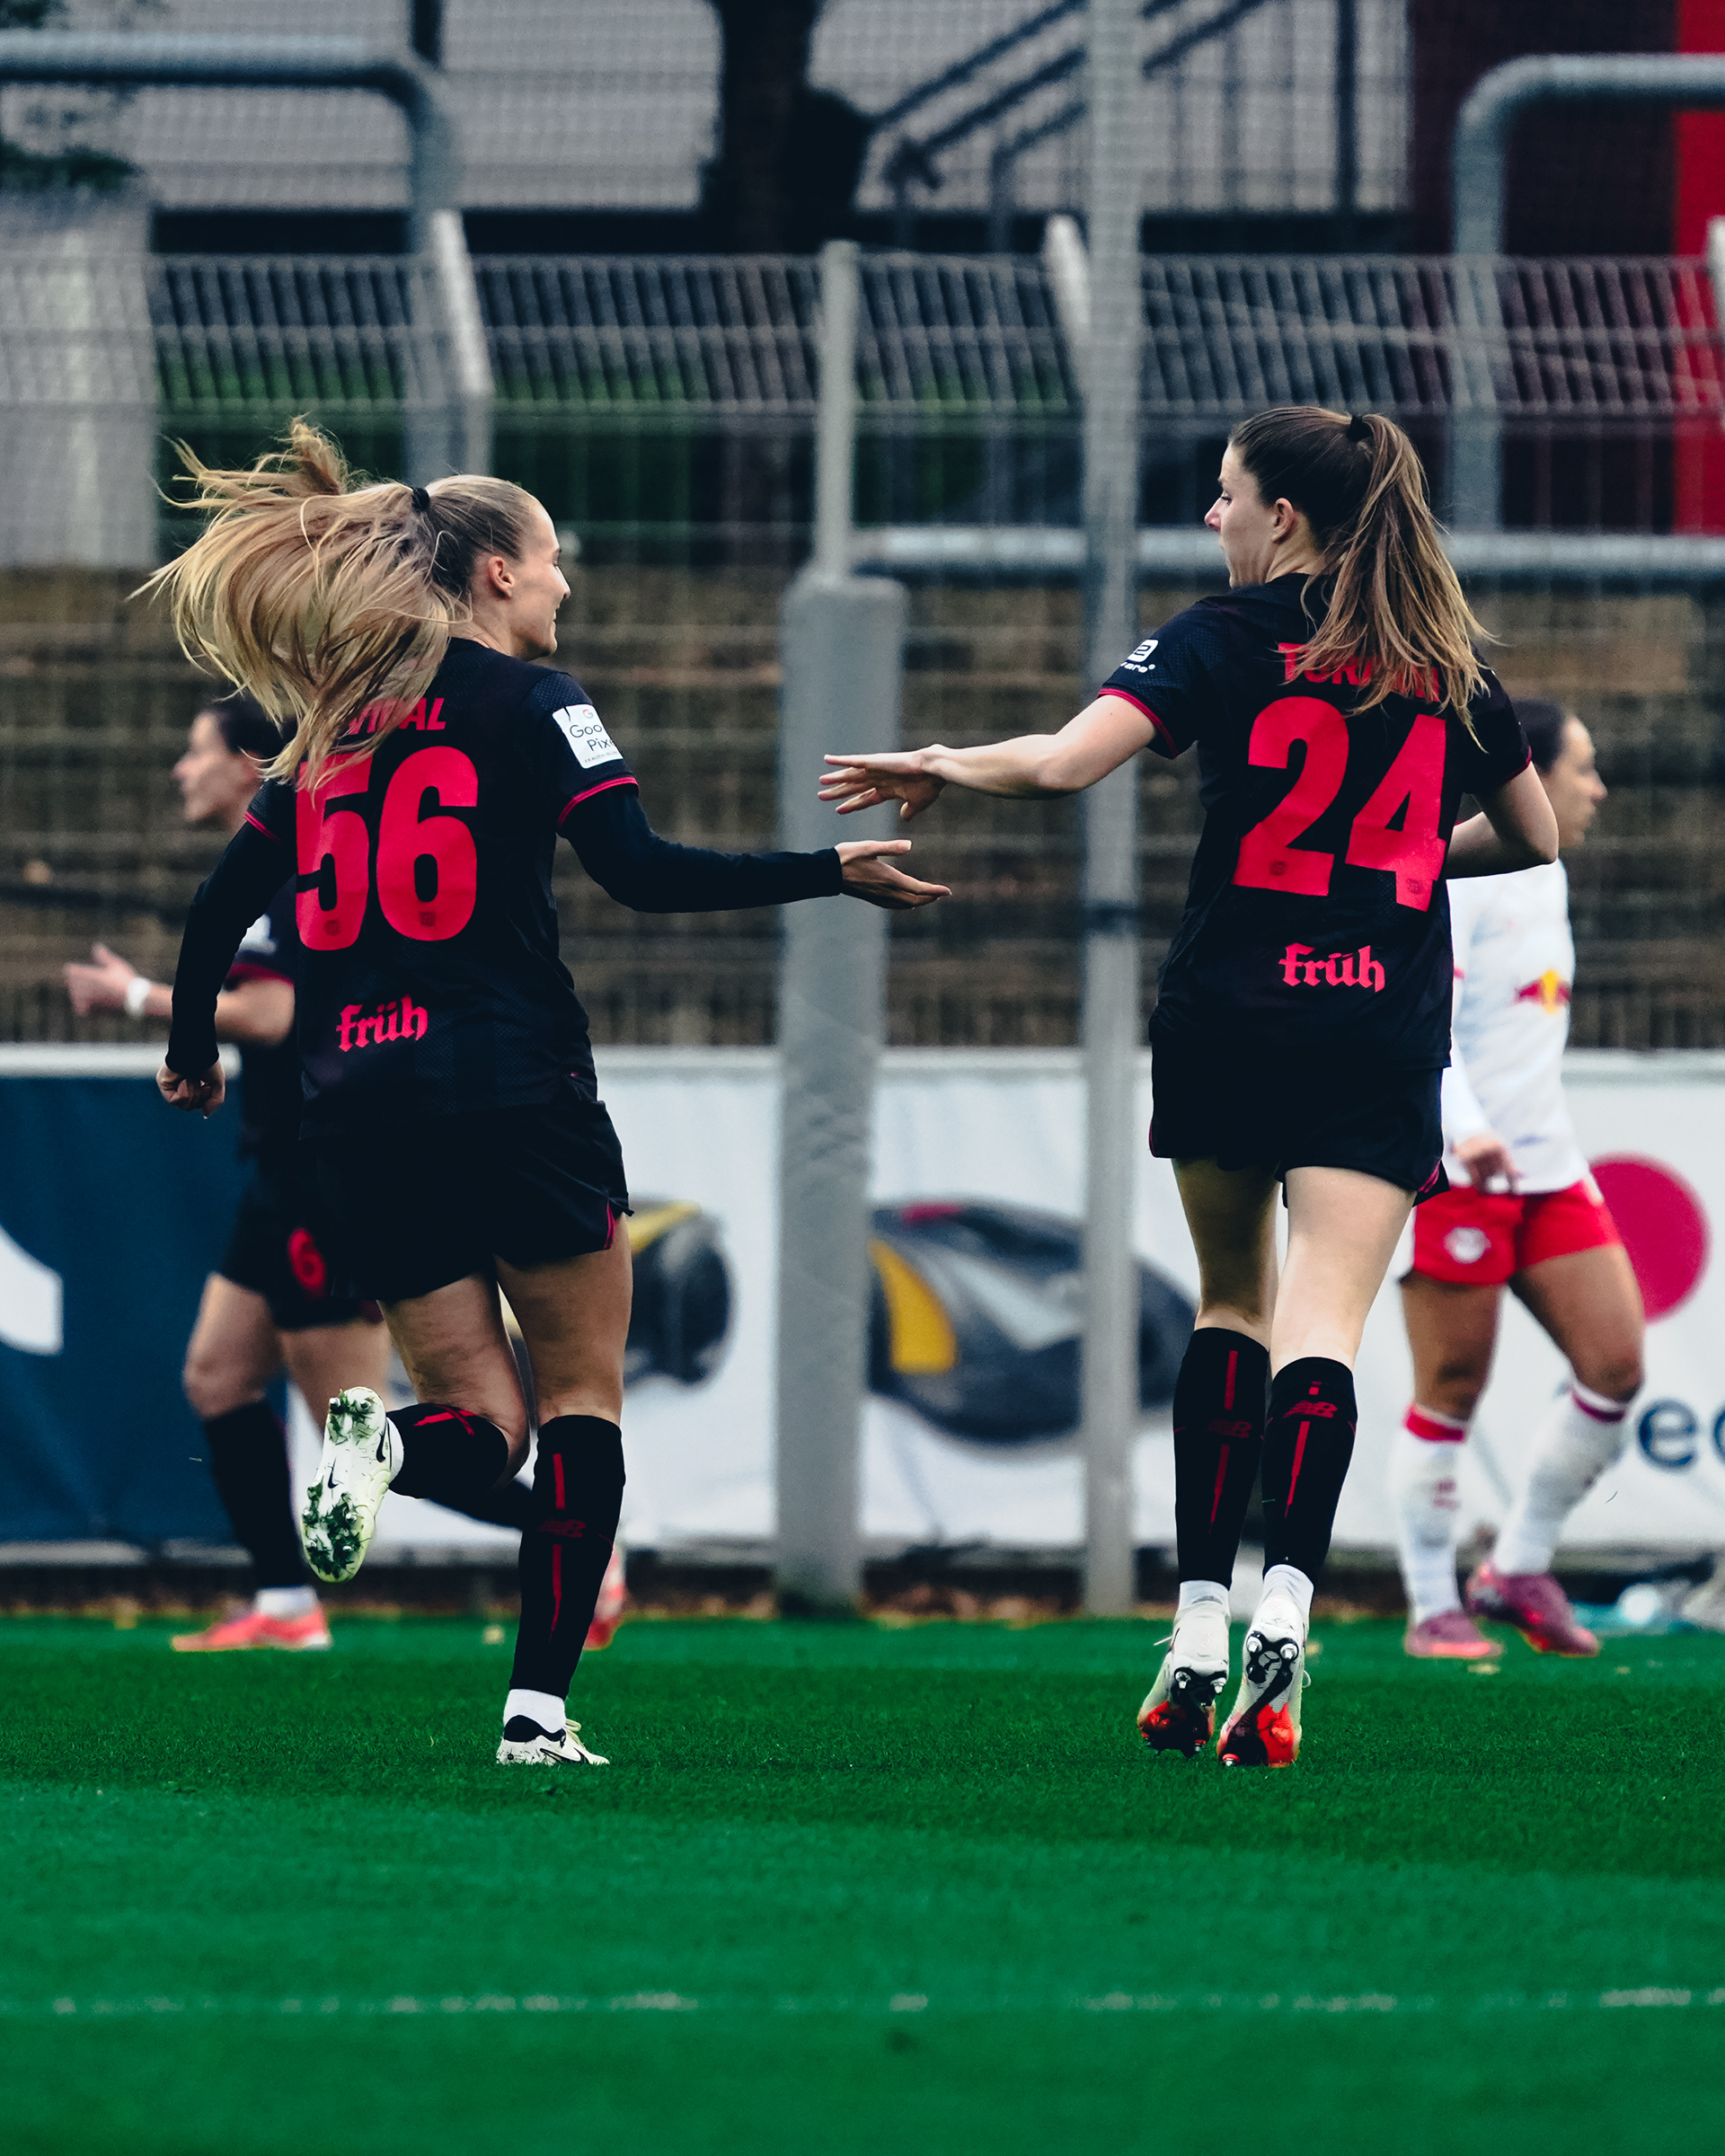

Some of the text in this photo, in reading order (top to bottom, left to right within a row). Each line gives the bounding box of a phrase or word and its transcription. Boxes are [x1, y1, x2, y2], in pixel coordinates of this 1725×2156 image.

[1232, 695, 1446, 913] 24
[296, 746, 479, 951] 56
[1278, 941, 1385, 993] früh
[335, 994, 429, 1053] früh
[288, 1227, 325, 1290] 6
